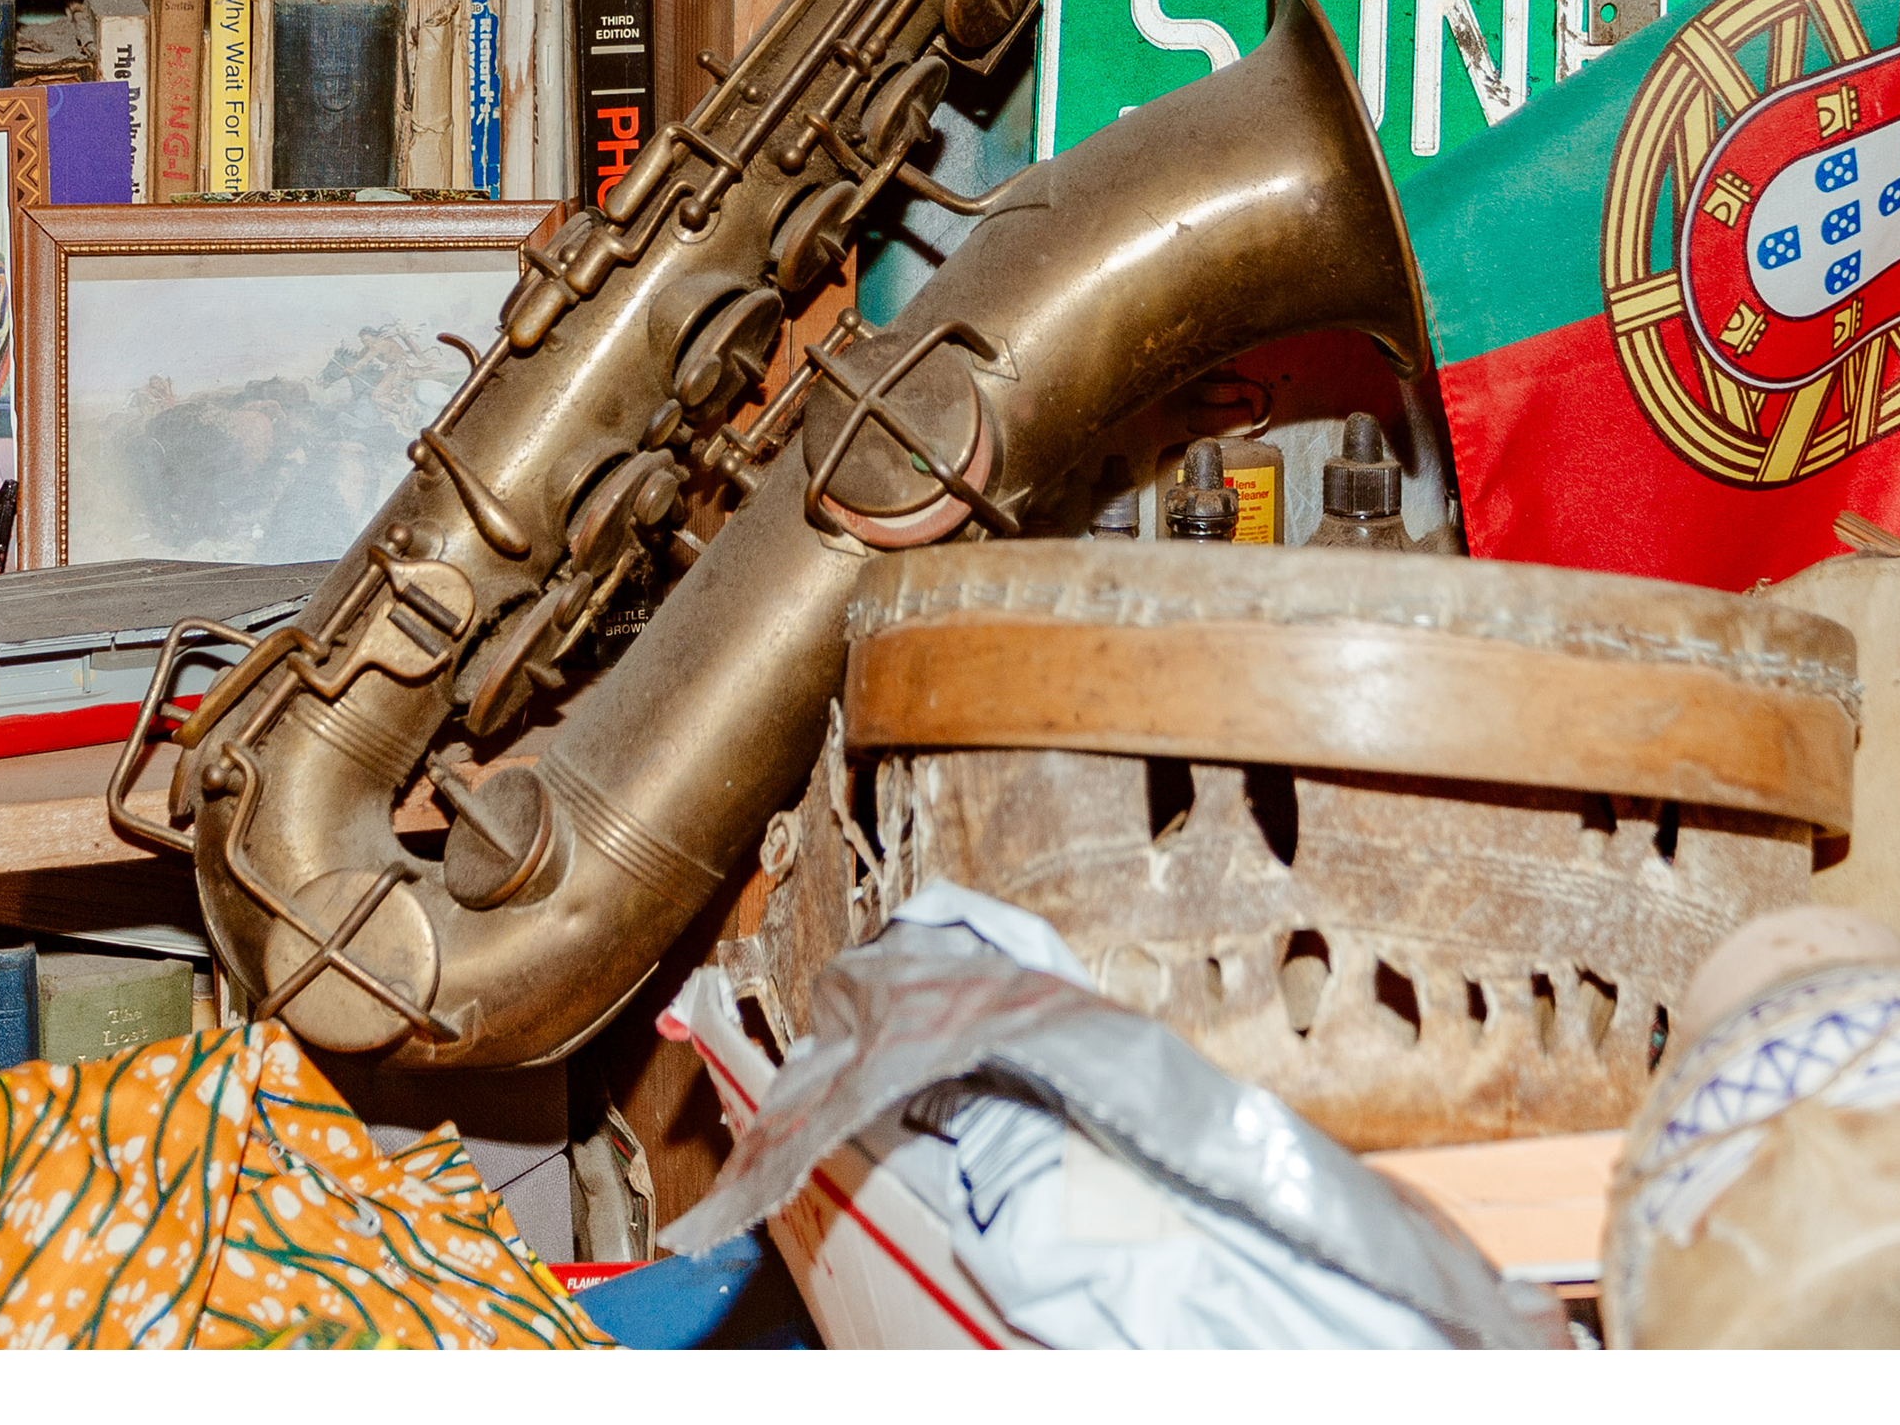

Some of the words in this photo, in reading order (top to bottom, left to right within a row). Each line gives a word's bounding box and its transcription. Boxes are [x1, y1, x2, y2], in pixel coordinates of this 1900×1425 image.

[600, 14, 636, 28] THIRD
[595, 27, 641, 41] EDITION
[114, 43, 133, 80] The
[224, 41, 247, 94] Wait
[224, 100, 246, 142] For
[1235, 479, 1257, 491] lens
[107, 1007, 144, 1024] The
[101, 1028, 150, 1047] Lost
